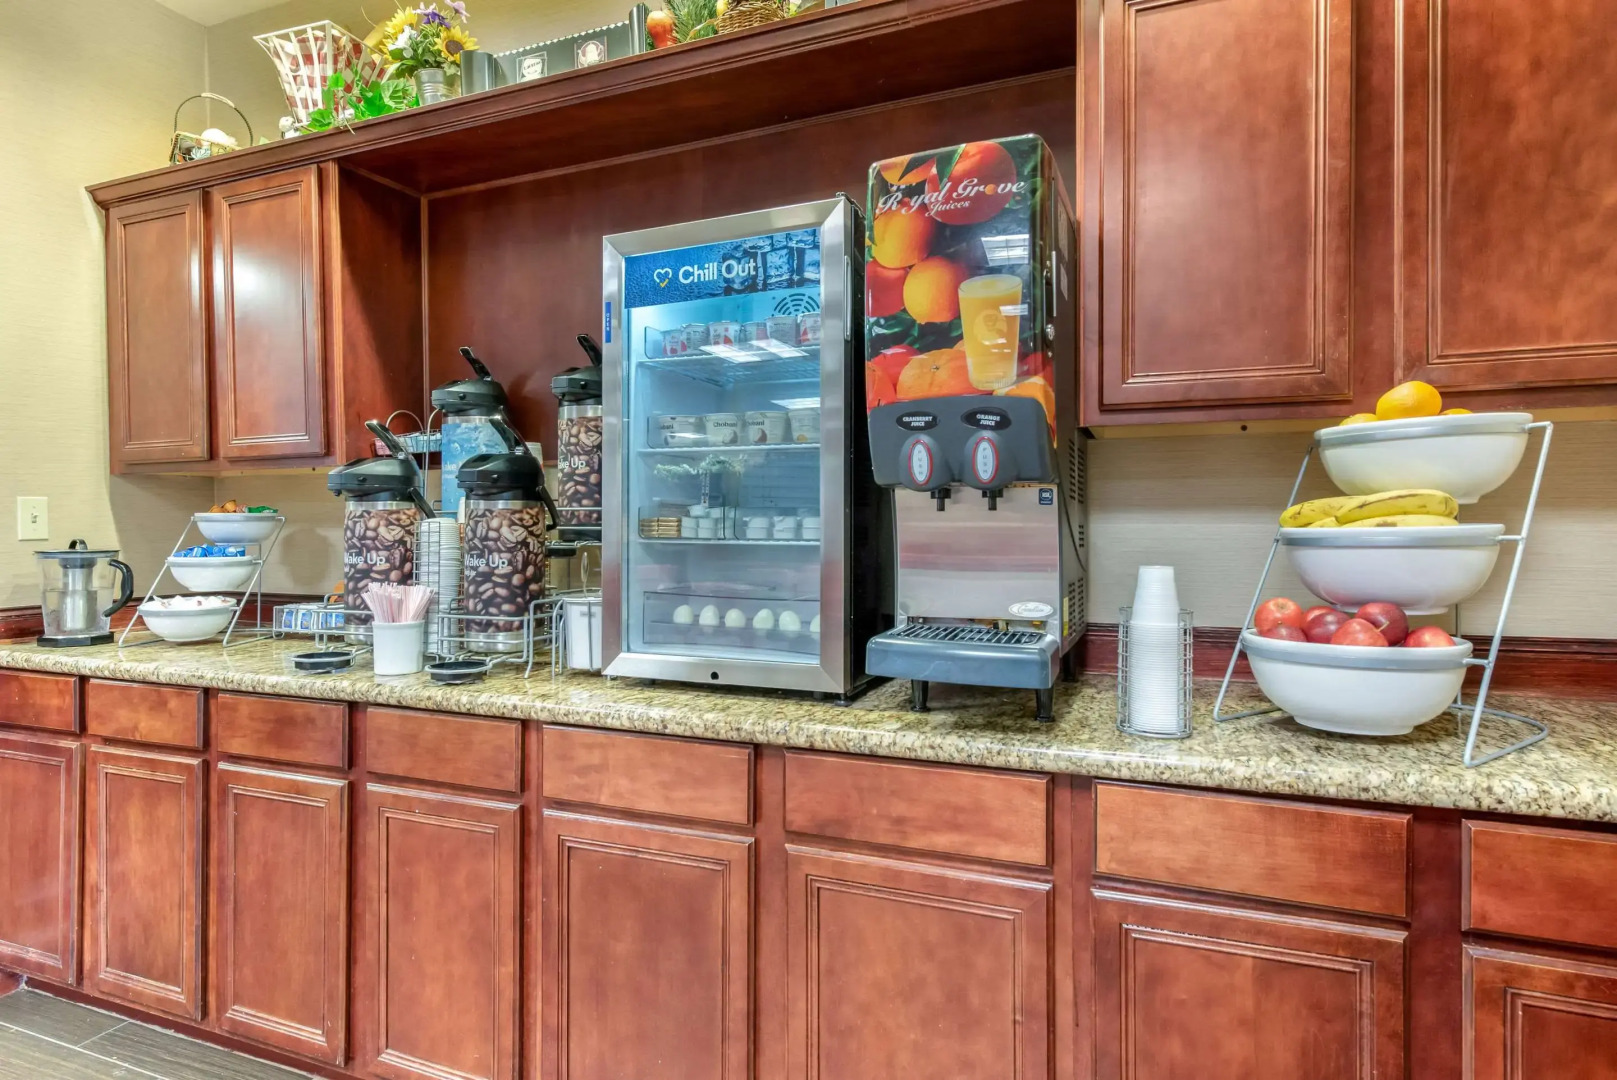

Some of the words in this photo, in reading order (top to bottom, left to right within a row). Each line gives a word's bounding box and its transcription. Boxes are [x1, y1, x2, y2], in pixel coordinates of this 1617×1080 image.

[876, 181, 951, 215] Royal
[953, 178, 1027, 198] Grove
[925, 200, 970, 216] Juices
[679, 262, 718, 284] Chill
[722, 258, 756, 278] Out
[571, 458, 586, 470] Up
[366, 552, 386, 567] Up
[489, 554, 509, 570] Up
